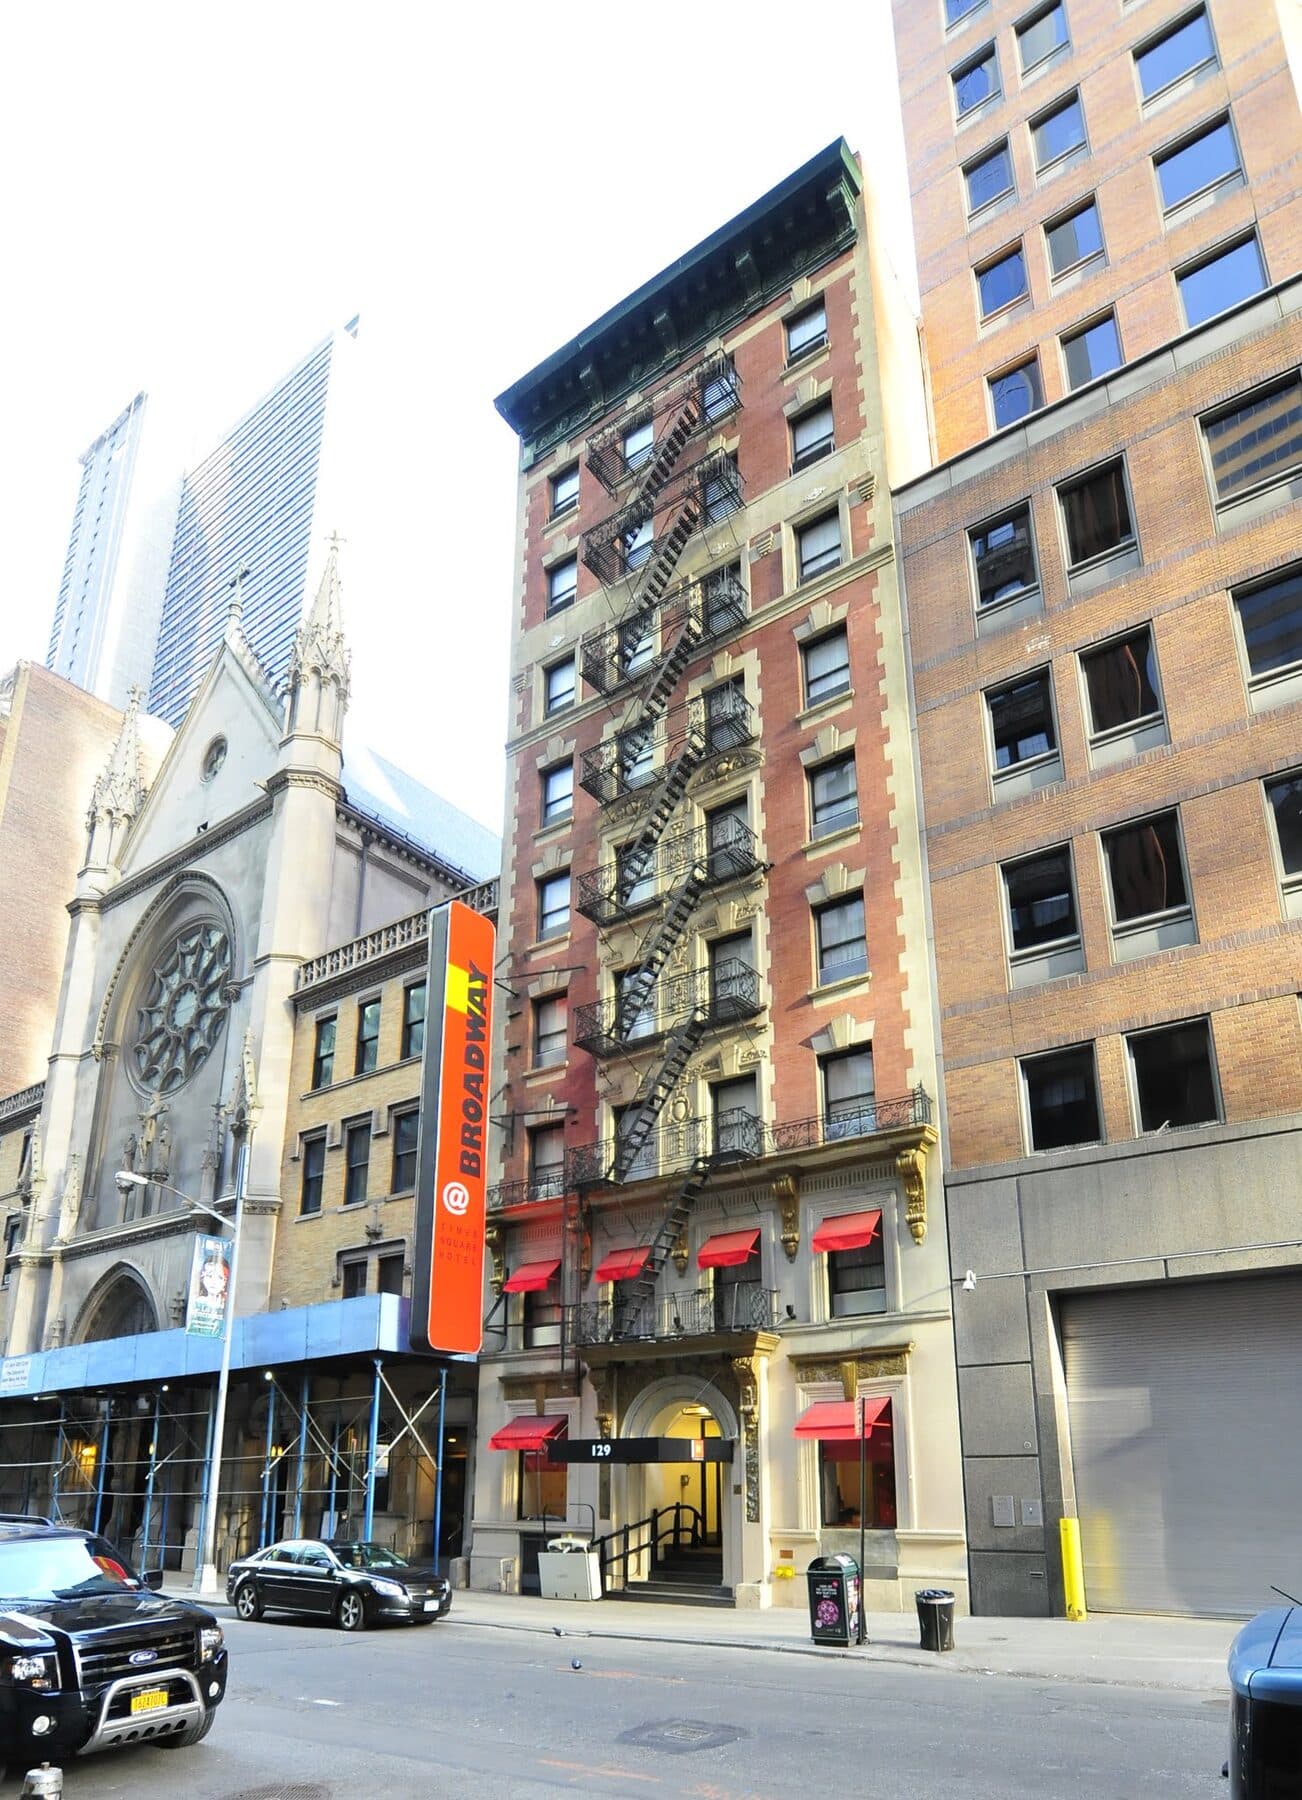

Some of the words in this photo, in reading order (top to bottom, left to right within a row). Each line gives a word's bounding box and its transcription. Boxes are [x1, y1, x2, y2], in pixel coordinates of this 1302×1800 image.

[442, 1181, 470, 1216] @
[459, 960, 489, 1180] BROADWAY
[440, 1236, 477, 1252] SQUARE
[439, 1249, 477, 1266] HOTEL
[591, 1444, 611, 1457] 129
